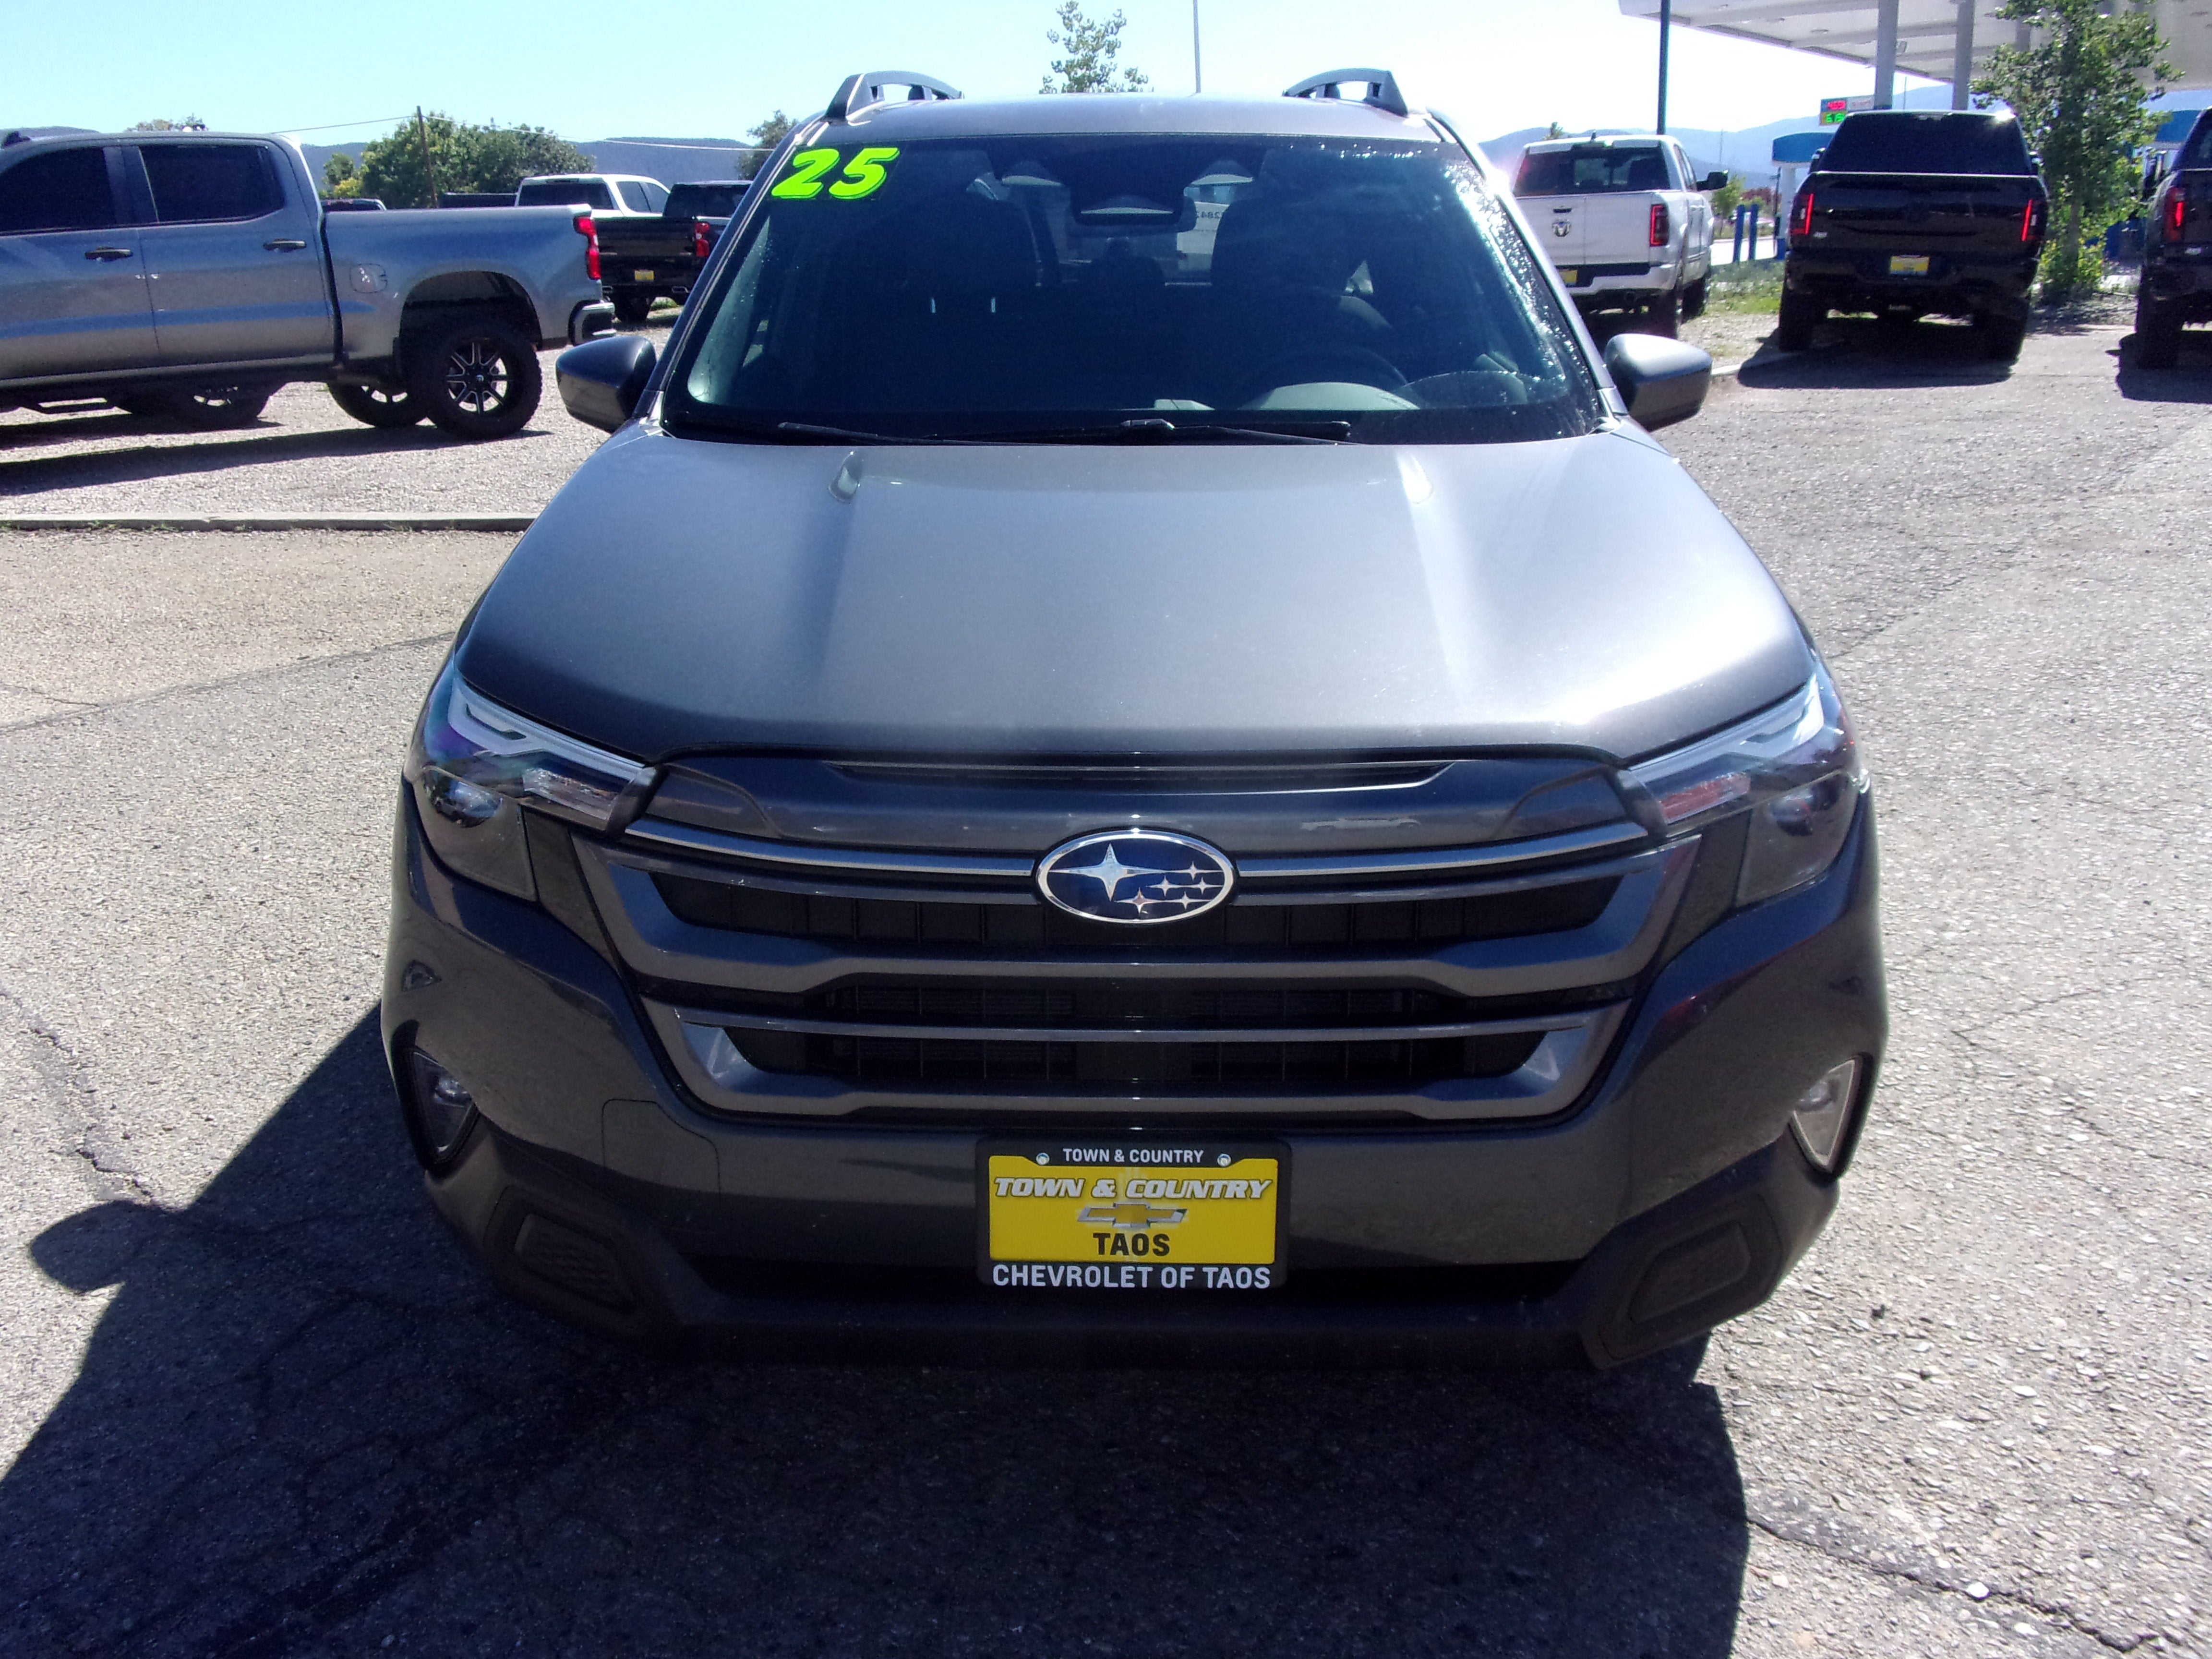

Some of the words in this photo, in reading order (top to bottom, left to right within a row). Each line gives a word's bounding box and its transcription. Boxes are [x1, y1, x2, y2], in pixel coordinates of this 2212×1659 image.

[771, 147, 900, 199] 25
[1062, 1148, 1110, 1163] TOWN
[1114, 1149, 1125, 1163] &
[1129, 1149, 1204, 1163] COUNTRY
[994, 1177, 1086, 1198] TOWN
[1091, 1178, 1117, 1199] &
[1125, 1178, 1274, 1200] COUNTRY
[1093, 1232, 1170, 1257] TAOS
[992, 1264, 1153, 1288] CHEVROLET
[1160, 1266, 1195, 1288] OF
[1202, 1266, 1271, 1289] TAOS
